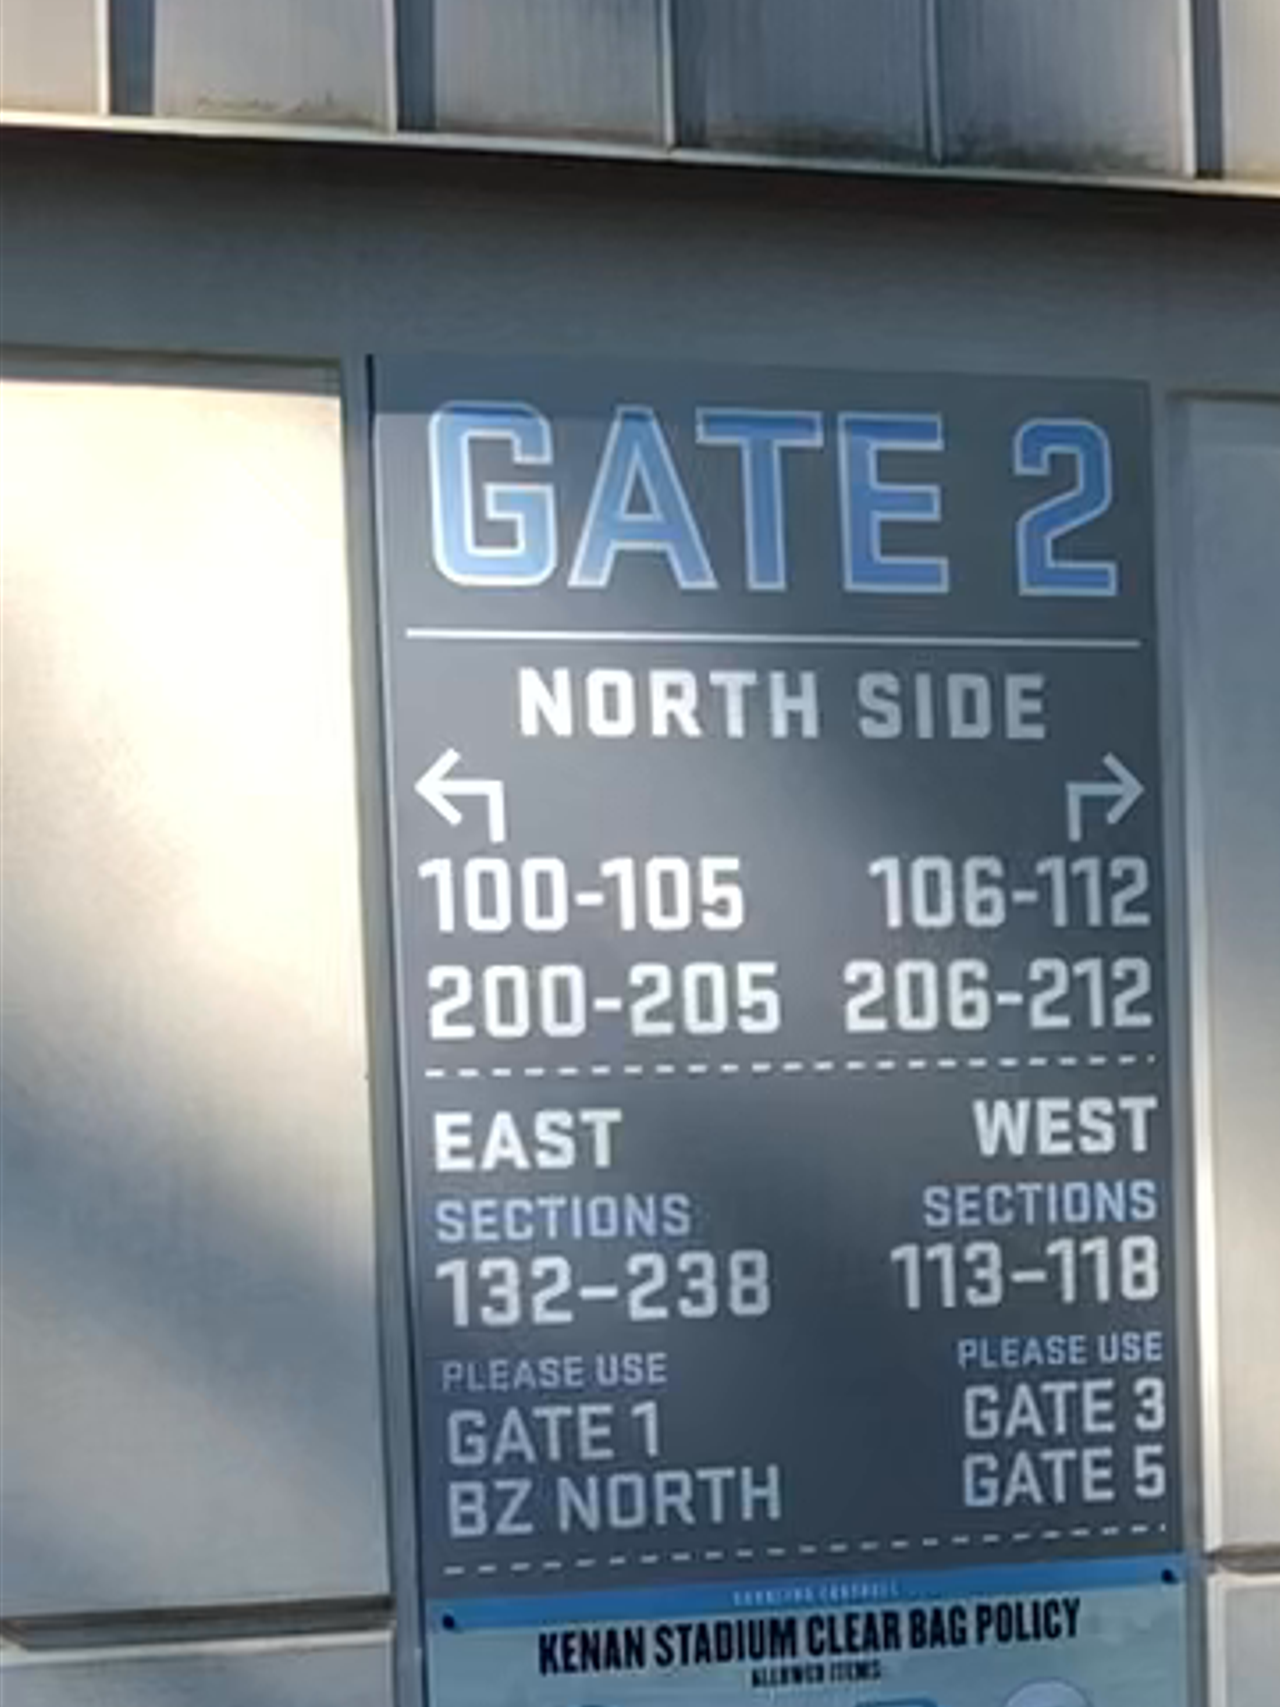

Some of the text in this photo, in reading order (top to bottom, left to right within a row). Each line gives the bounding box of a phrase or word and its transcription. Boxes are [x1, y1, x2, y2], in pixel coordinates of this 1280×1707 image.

[428, 400, 1119, 597] GATE 2
[518, 667, 1047, 740] NORTH SIDE
[417, 855, 745, 933] 100-105
[869, 855, 1151, 929] 106-112
[427, 960, 781, 1040] 200-205
[843, 957, 1153, 1033] 206-212
[434, 1109, 622, 1172] EAST
[973, 1096, 1159, 1158] WEST
[436, 1193, 691, 1244] SECTIONS
[924, 1179, 1158, 1228] SECTIONS
[435, 1249, 772, 1328] 132-238
[890, 1235, 1160, 1310] 113-118
[442, 1352, 668, 1393] PLEASE USE
[957, 1330, 1164, 1369] PLEASE USE
[448, 1401, 660, 1466] GATE 1
[964, 1376, 1167, 1440] GATE 3
[449, 1464, 782, 1537] BZ NORTH
[964, 1445, 1167, 1507] GATE 5
[539, 1596, 1081, 1676] KENAN STADIUM CLEAR BAG POLICY
